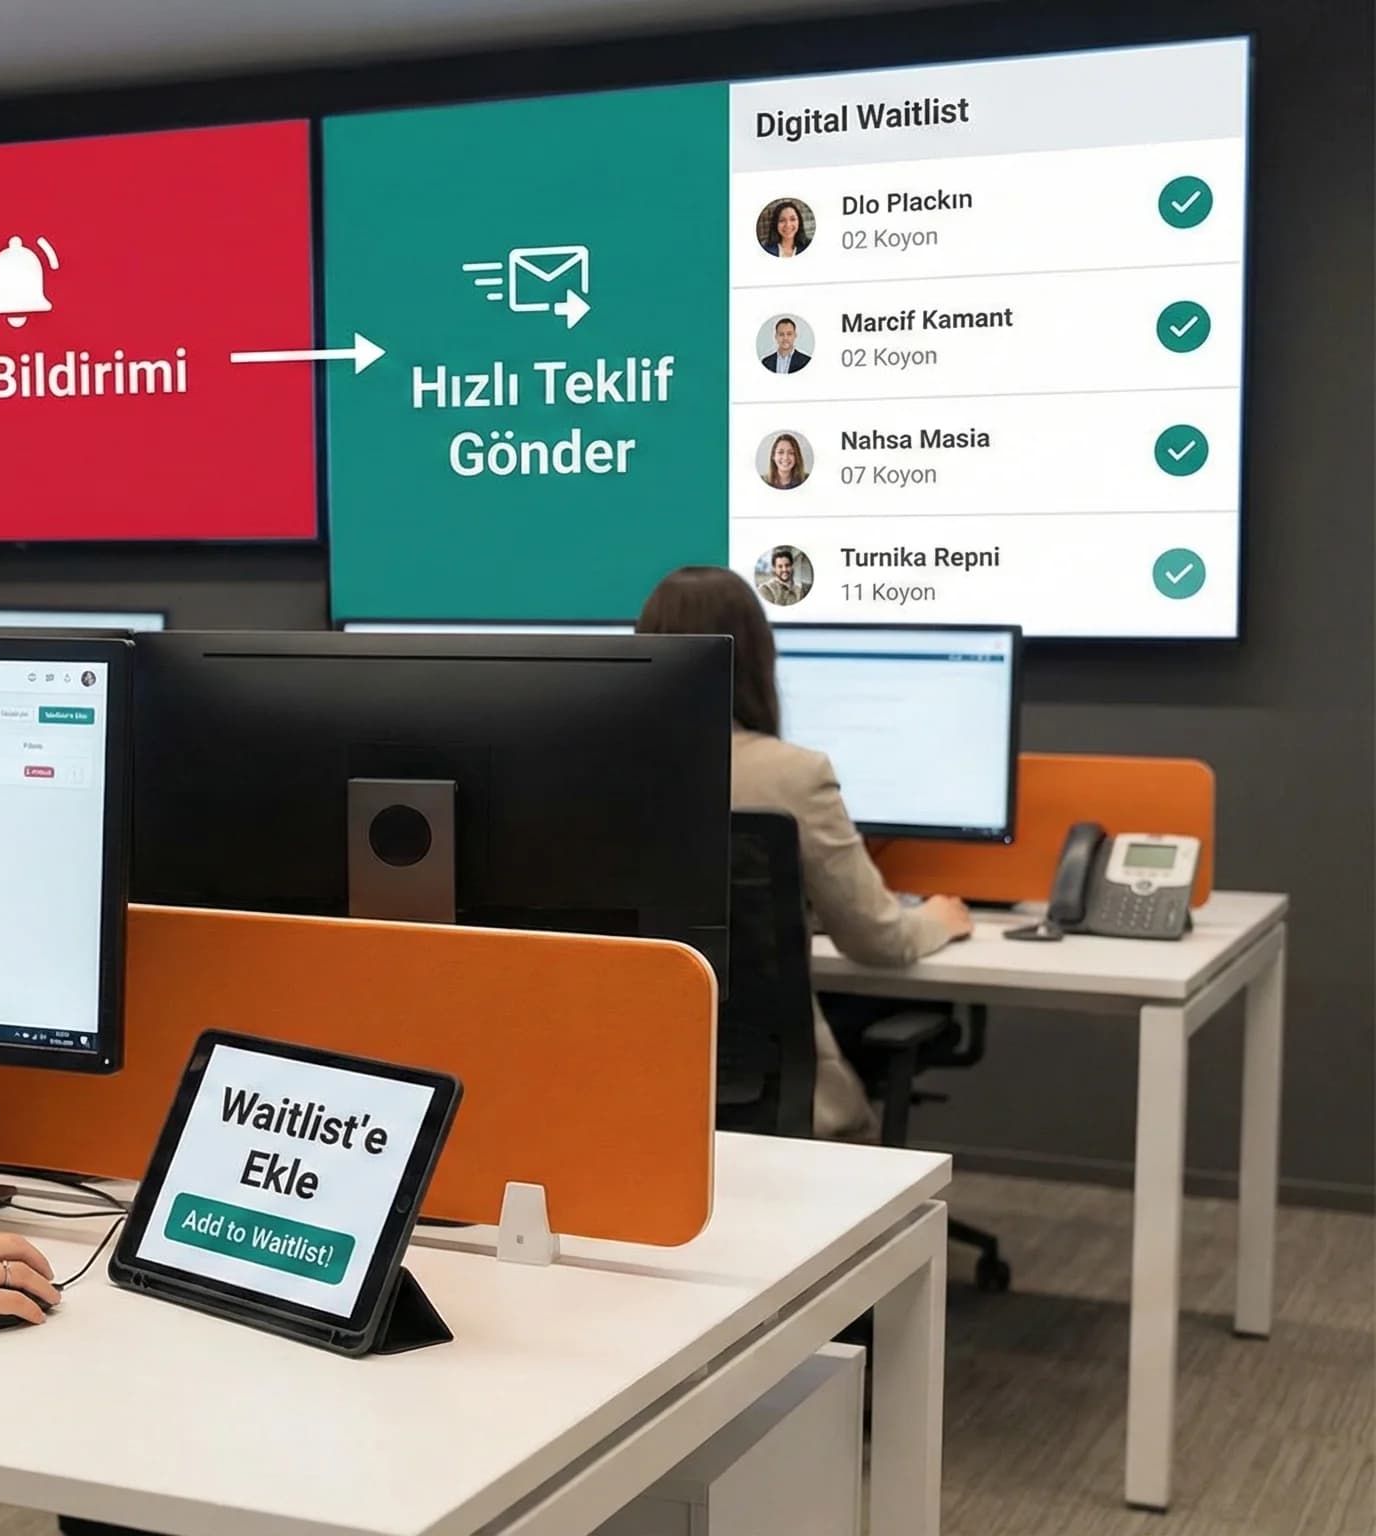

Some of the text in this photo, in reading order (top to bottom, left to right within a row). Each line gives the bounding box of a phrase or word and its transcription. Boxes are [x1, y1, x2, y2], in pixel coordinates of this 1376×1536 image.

[756, 97, 969, 143] Digital Waitlist
[841, 228, 938, 252] 02 Koyon
[841, 307, 1014, 334] Marcif Kamant
[841, 347, 937, 371] 02 Koyon
[413, 355, 675, 409] Hızlı Teklif
[449, 428, 636, 477] Gönder
[841, 427, 991, 451] Nahsa Masia
[840, 465, 937, 489] 07 Koyon
[840, 545, 1000, 572] Turnika Repni
[841, 583, 936, 606] 11 Koyon
[222, 1086, 388, 1154] Waitlist'e
[240, 1149, 319, 1199] Ekle
[181, 1209, 224, 1238] Add
[227, 1221, 246, 1243] to
